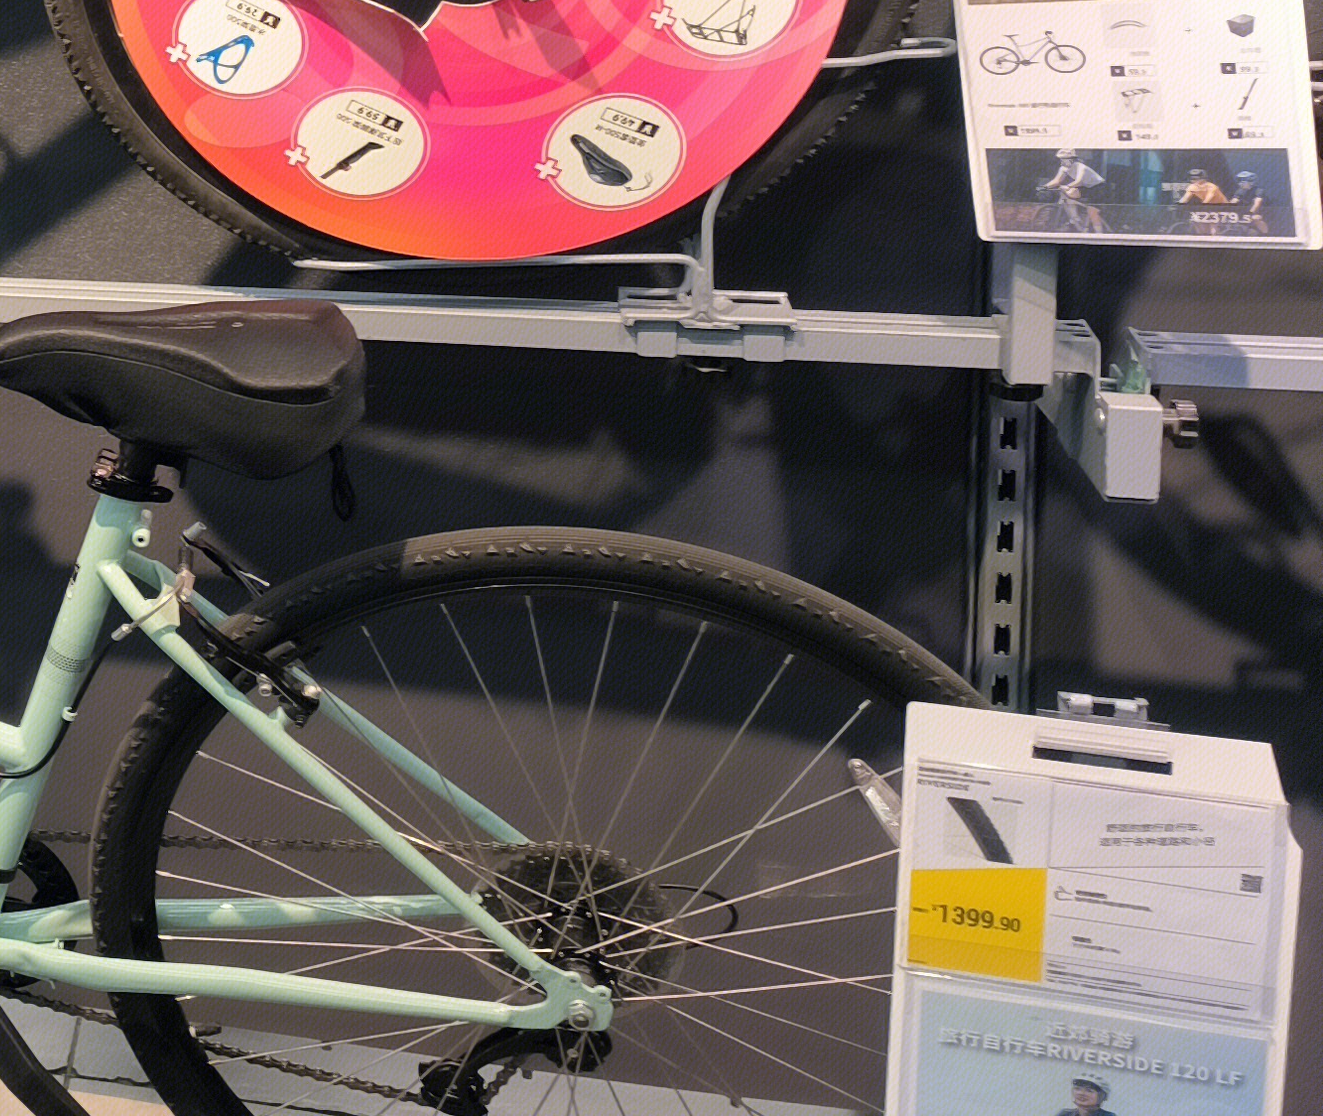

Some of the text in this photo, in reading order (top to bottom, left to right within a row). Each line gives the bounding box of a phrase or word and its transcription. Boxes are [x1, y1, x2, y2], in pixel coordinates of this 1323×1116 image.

[1046, 1021, 1135, 1050] 近郊骑游
[1169, 1061, 1210, 1082] 120
[1214, 1068, 1245, 1086] LF
